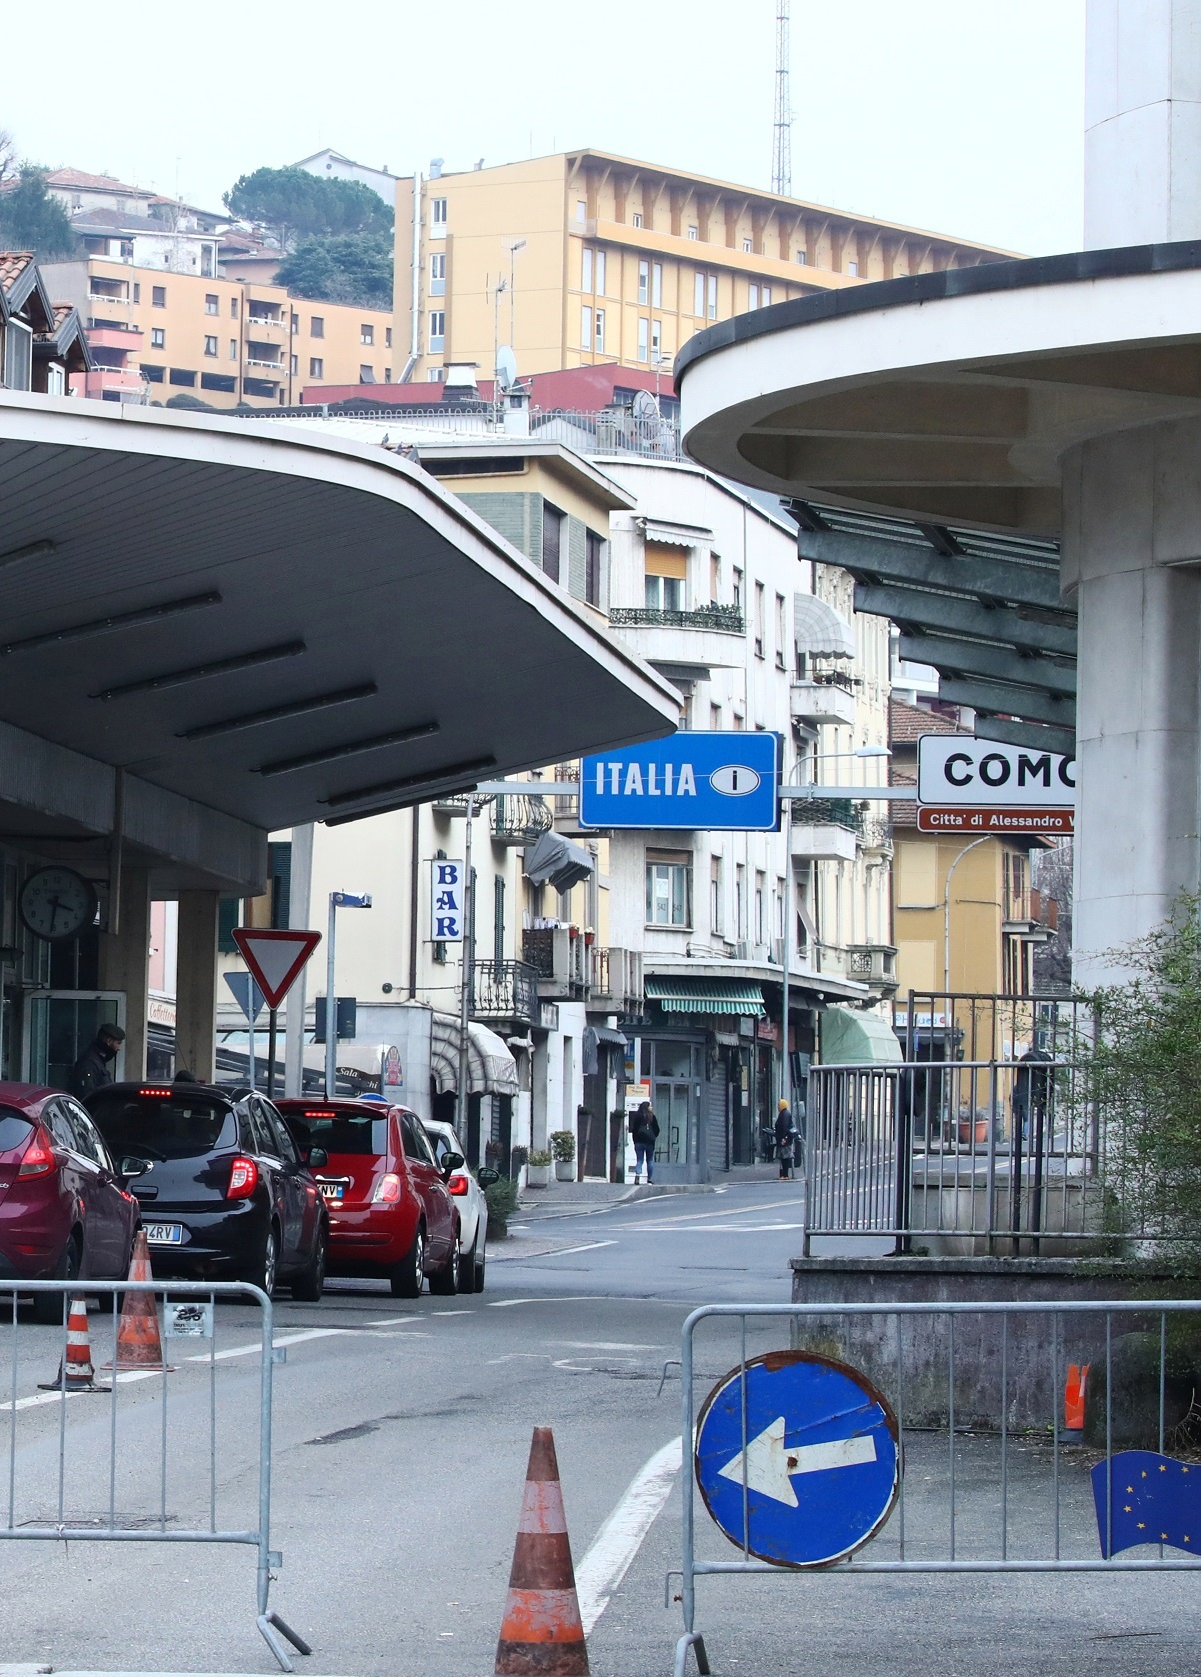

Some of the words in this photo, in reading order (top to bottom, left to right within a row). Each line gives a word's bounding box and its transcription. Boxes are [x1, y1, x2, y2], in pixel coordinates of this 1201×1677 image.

[596, 762, 697, 796] ITALIA
[930, 814, 967, 825] Citta'
[971, 814, 982, 825] di
[989, 814, 1063, 827] Alessandro
[436, 864, 459, 937] BAR
[340, 1067, 358, 1078] Sala
